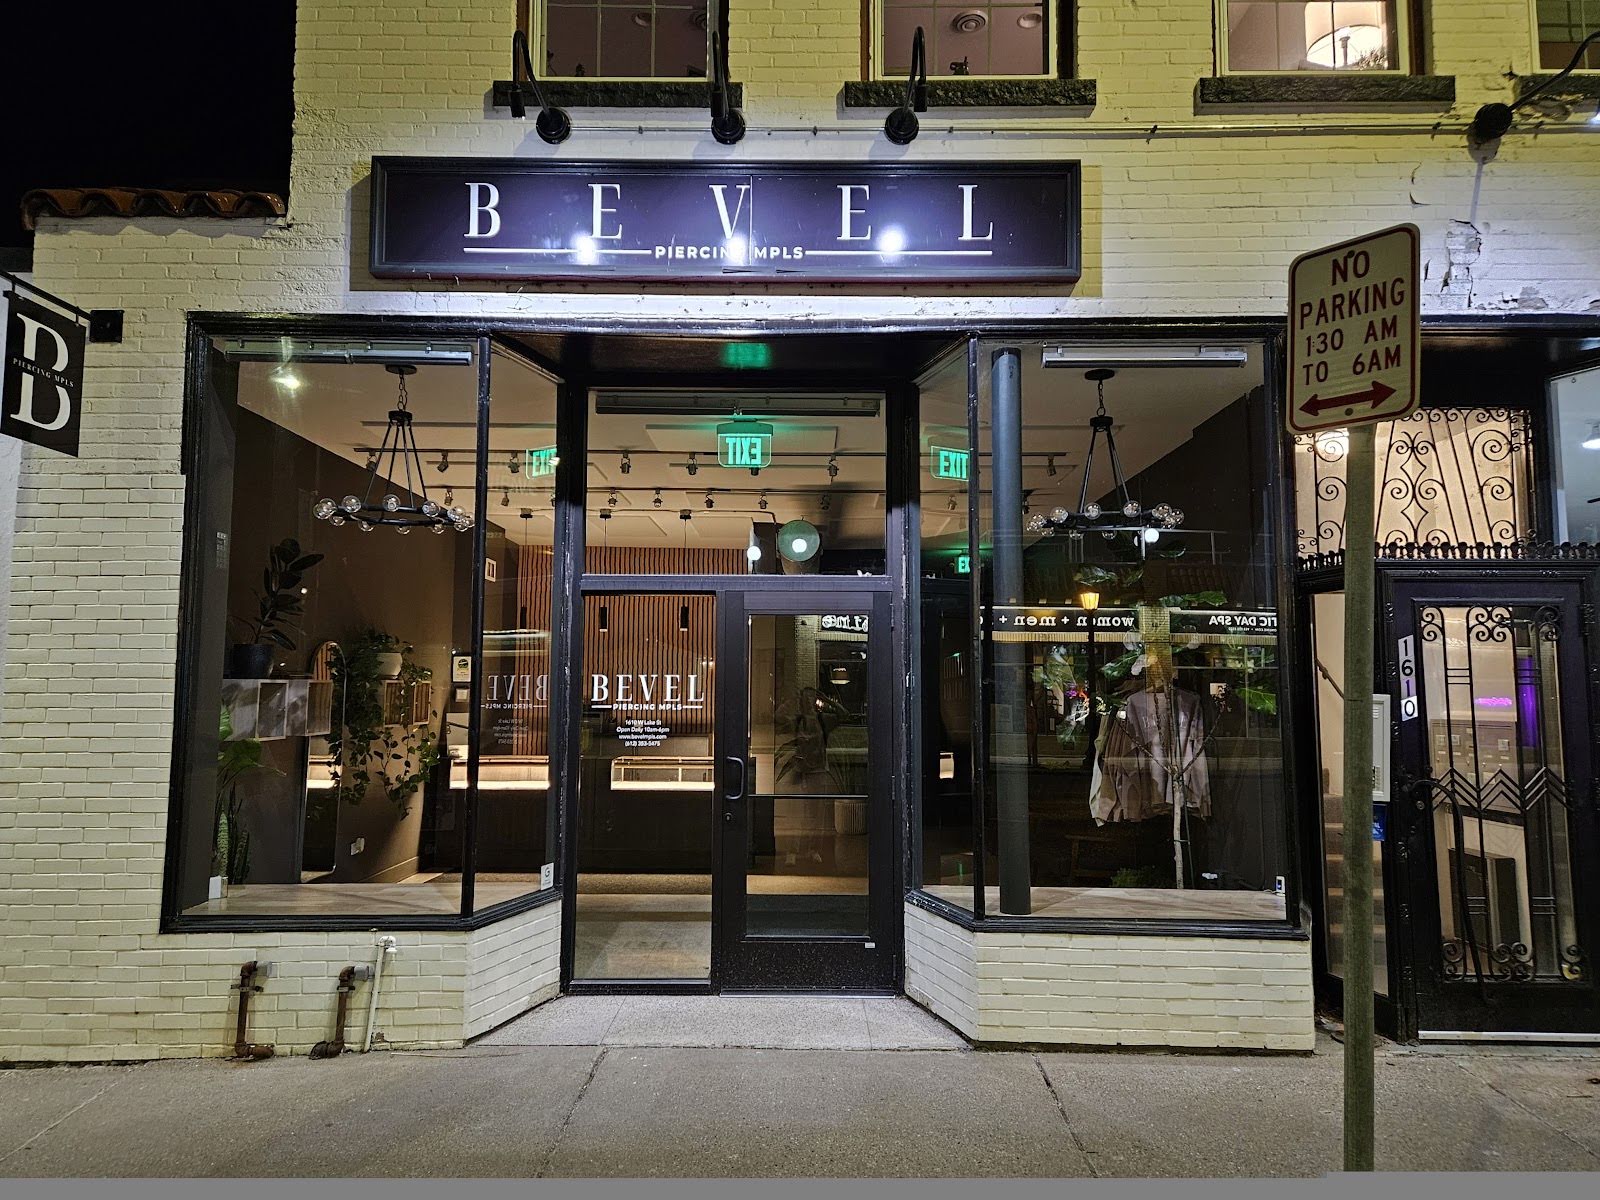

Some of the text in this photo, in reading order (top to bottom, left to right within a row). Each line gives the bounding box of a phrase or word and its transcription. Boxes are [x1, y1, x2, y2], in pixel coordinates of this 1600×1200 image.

[463, 182, 993, 240] BEVEL
[655, 245, 804, 259] PIERCIN MPLS
[1331, 250, 1370, 286] NO
[1300, 277, 1405, 330] PARKING
[1364, 315, 1398, 344] AM
[10, 313, 71, 431] B
[13, 357, 74, 388] PIERCING MPLS
[1303, 361, 1329, 386] TO
[940, 450, 968, 479] EXIT
[591, 674, 704, 701] BEVEL
[1401, 638, 1415, 717] 1610
[613, 703, 682, 711] PIERCING MPLS
